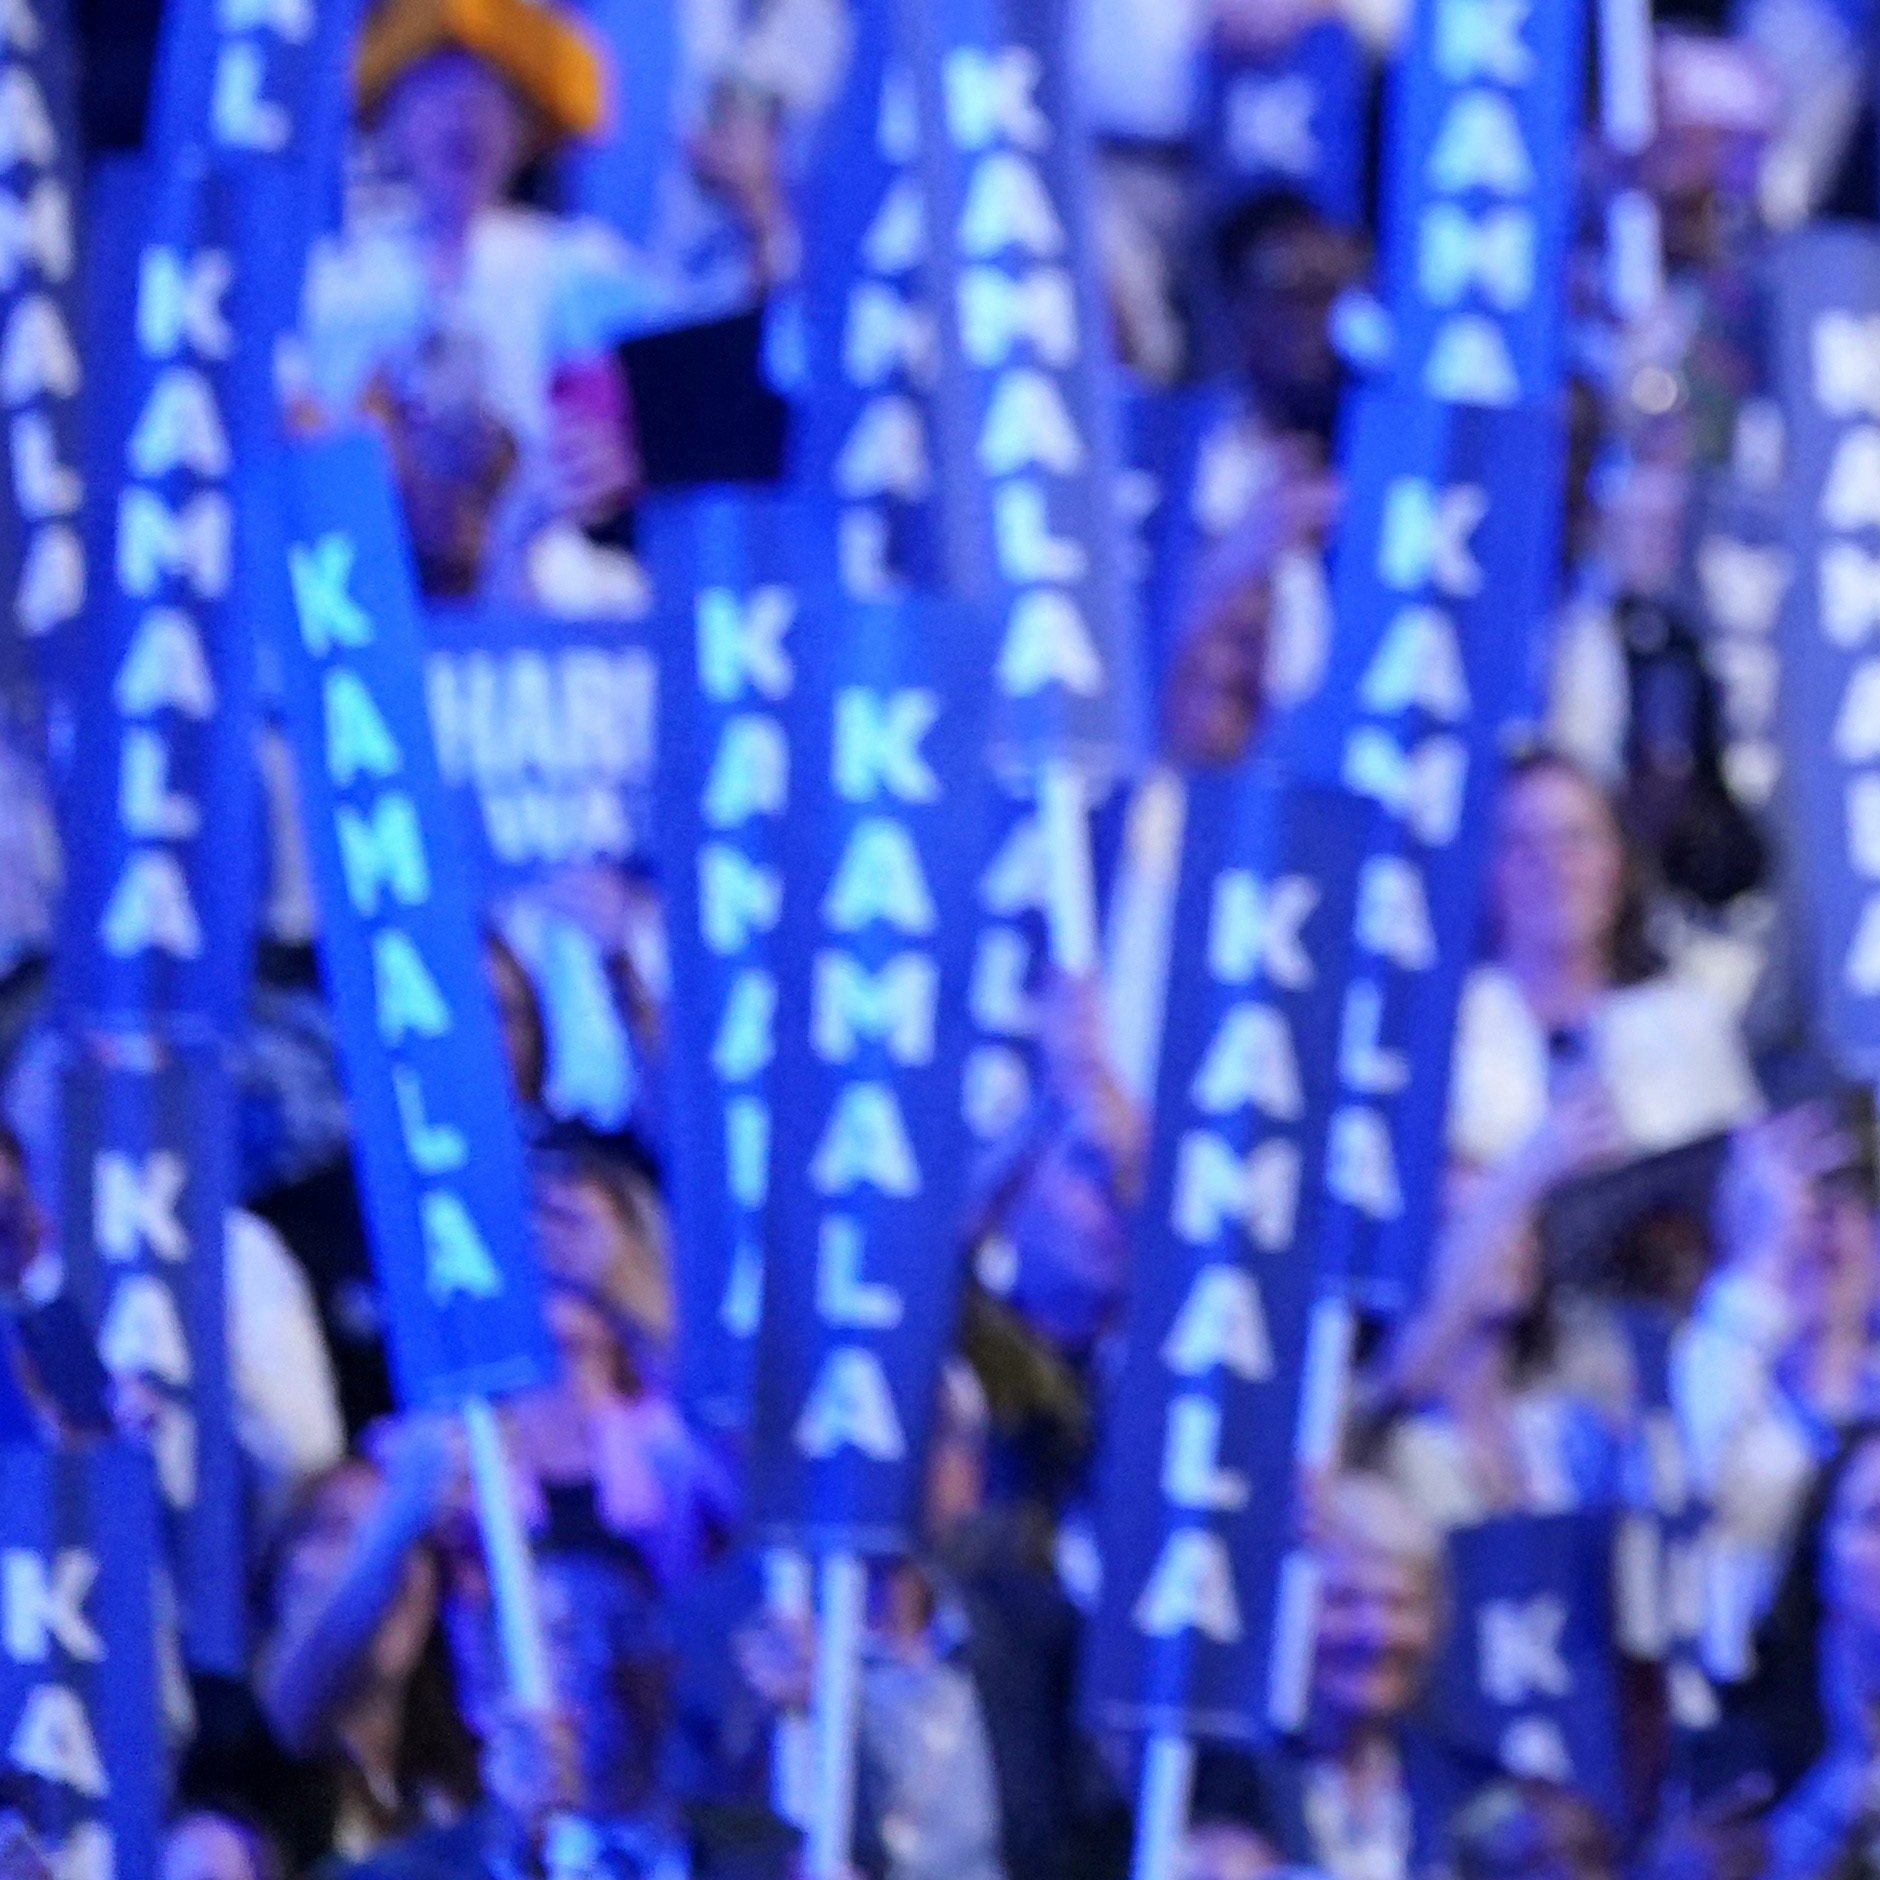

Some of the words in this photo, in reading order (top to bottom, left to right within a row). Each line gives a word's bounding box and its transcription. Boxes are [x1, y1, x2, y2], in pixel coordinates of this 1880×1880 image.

[100, 245, 235, 958] KAMALA
[945, 46, 1100, 698] KAMALA
[290, 535, 500, 1305] KAMALA
[798, 688, 940, 1460] KAMALA
[1138, 872, 1318, 1640] KAMALA
